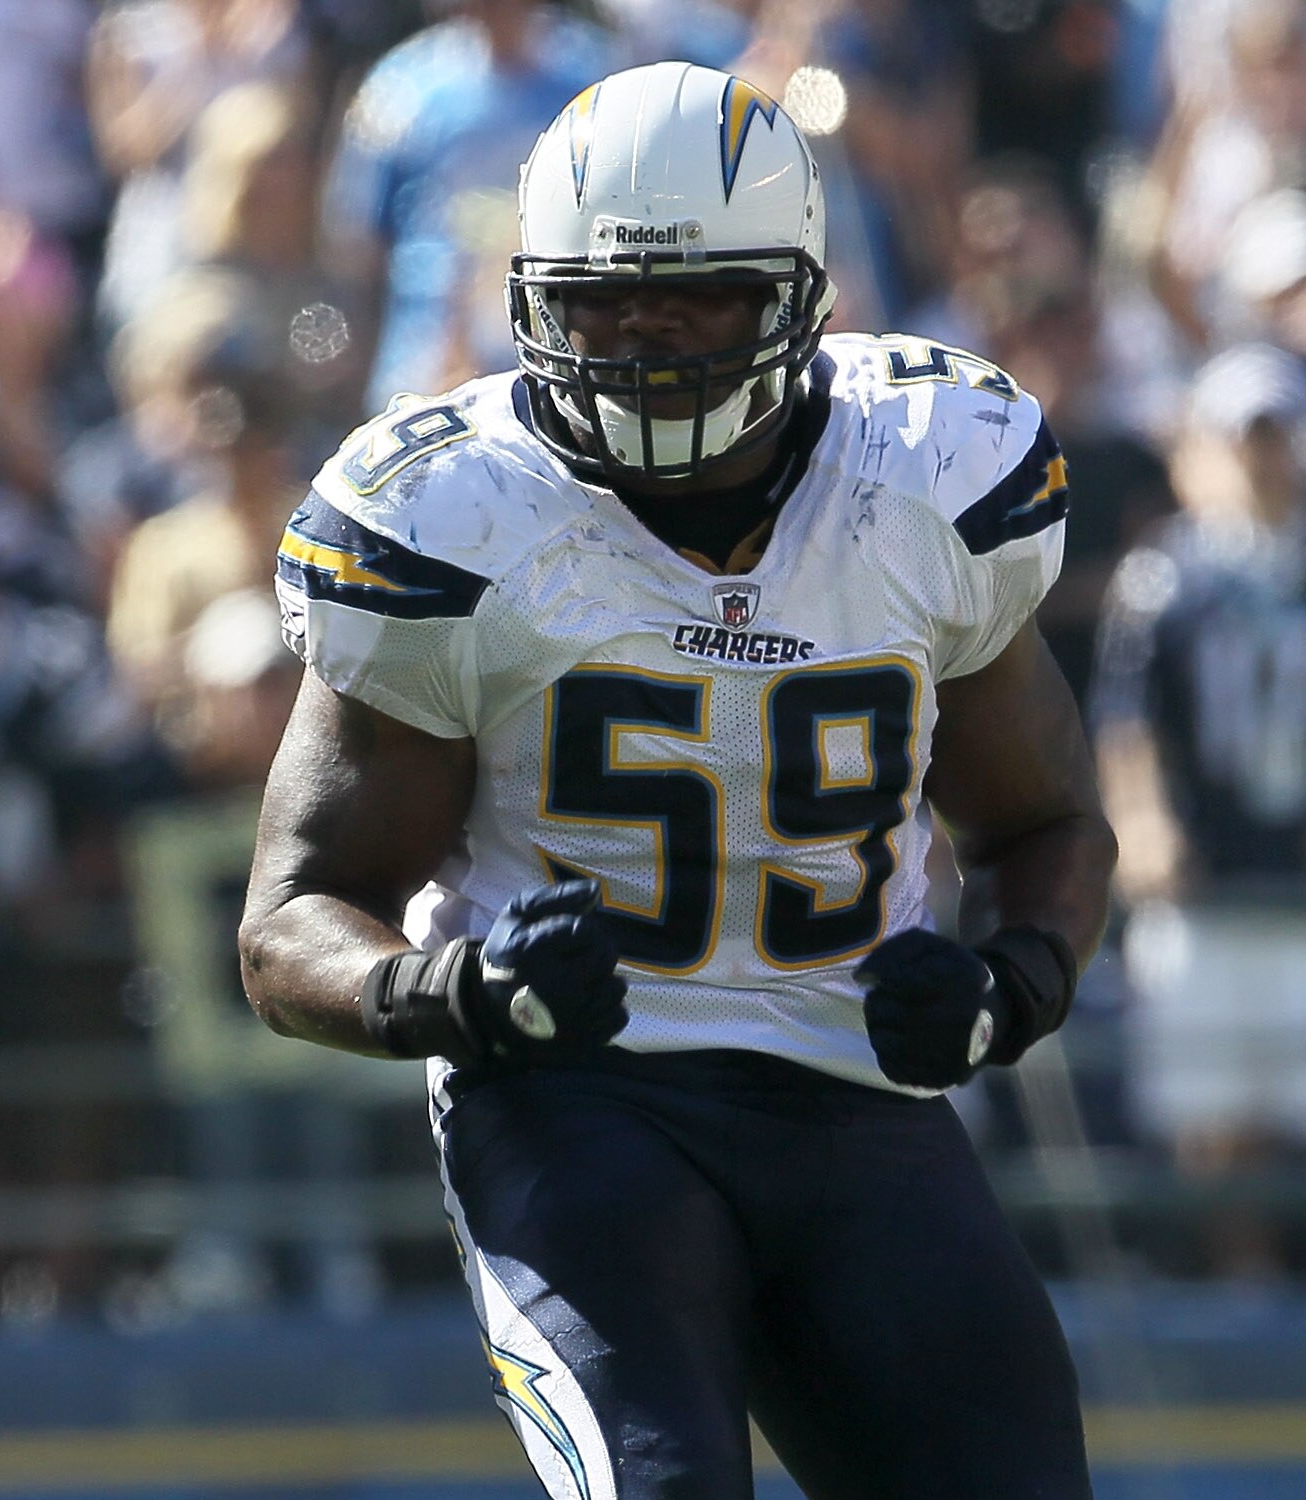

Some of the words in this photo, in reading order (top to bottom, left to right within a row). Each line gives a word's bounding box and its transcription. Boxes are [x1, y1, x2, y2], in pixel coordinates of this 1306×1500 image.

[616, 222, 678, 245] Riddell
[673, 624, 815, 664] CHARGERS
[538, 658, 923, 977] 59
